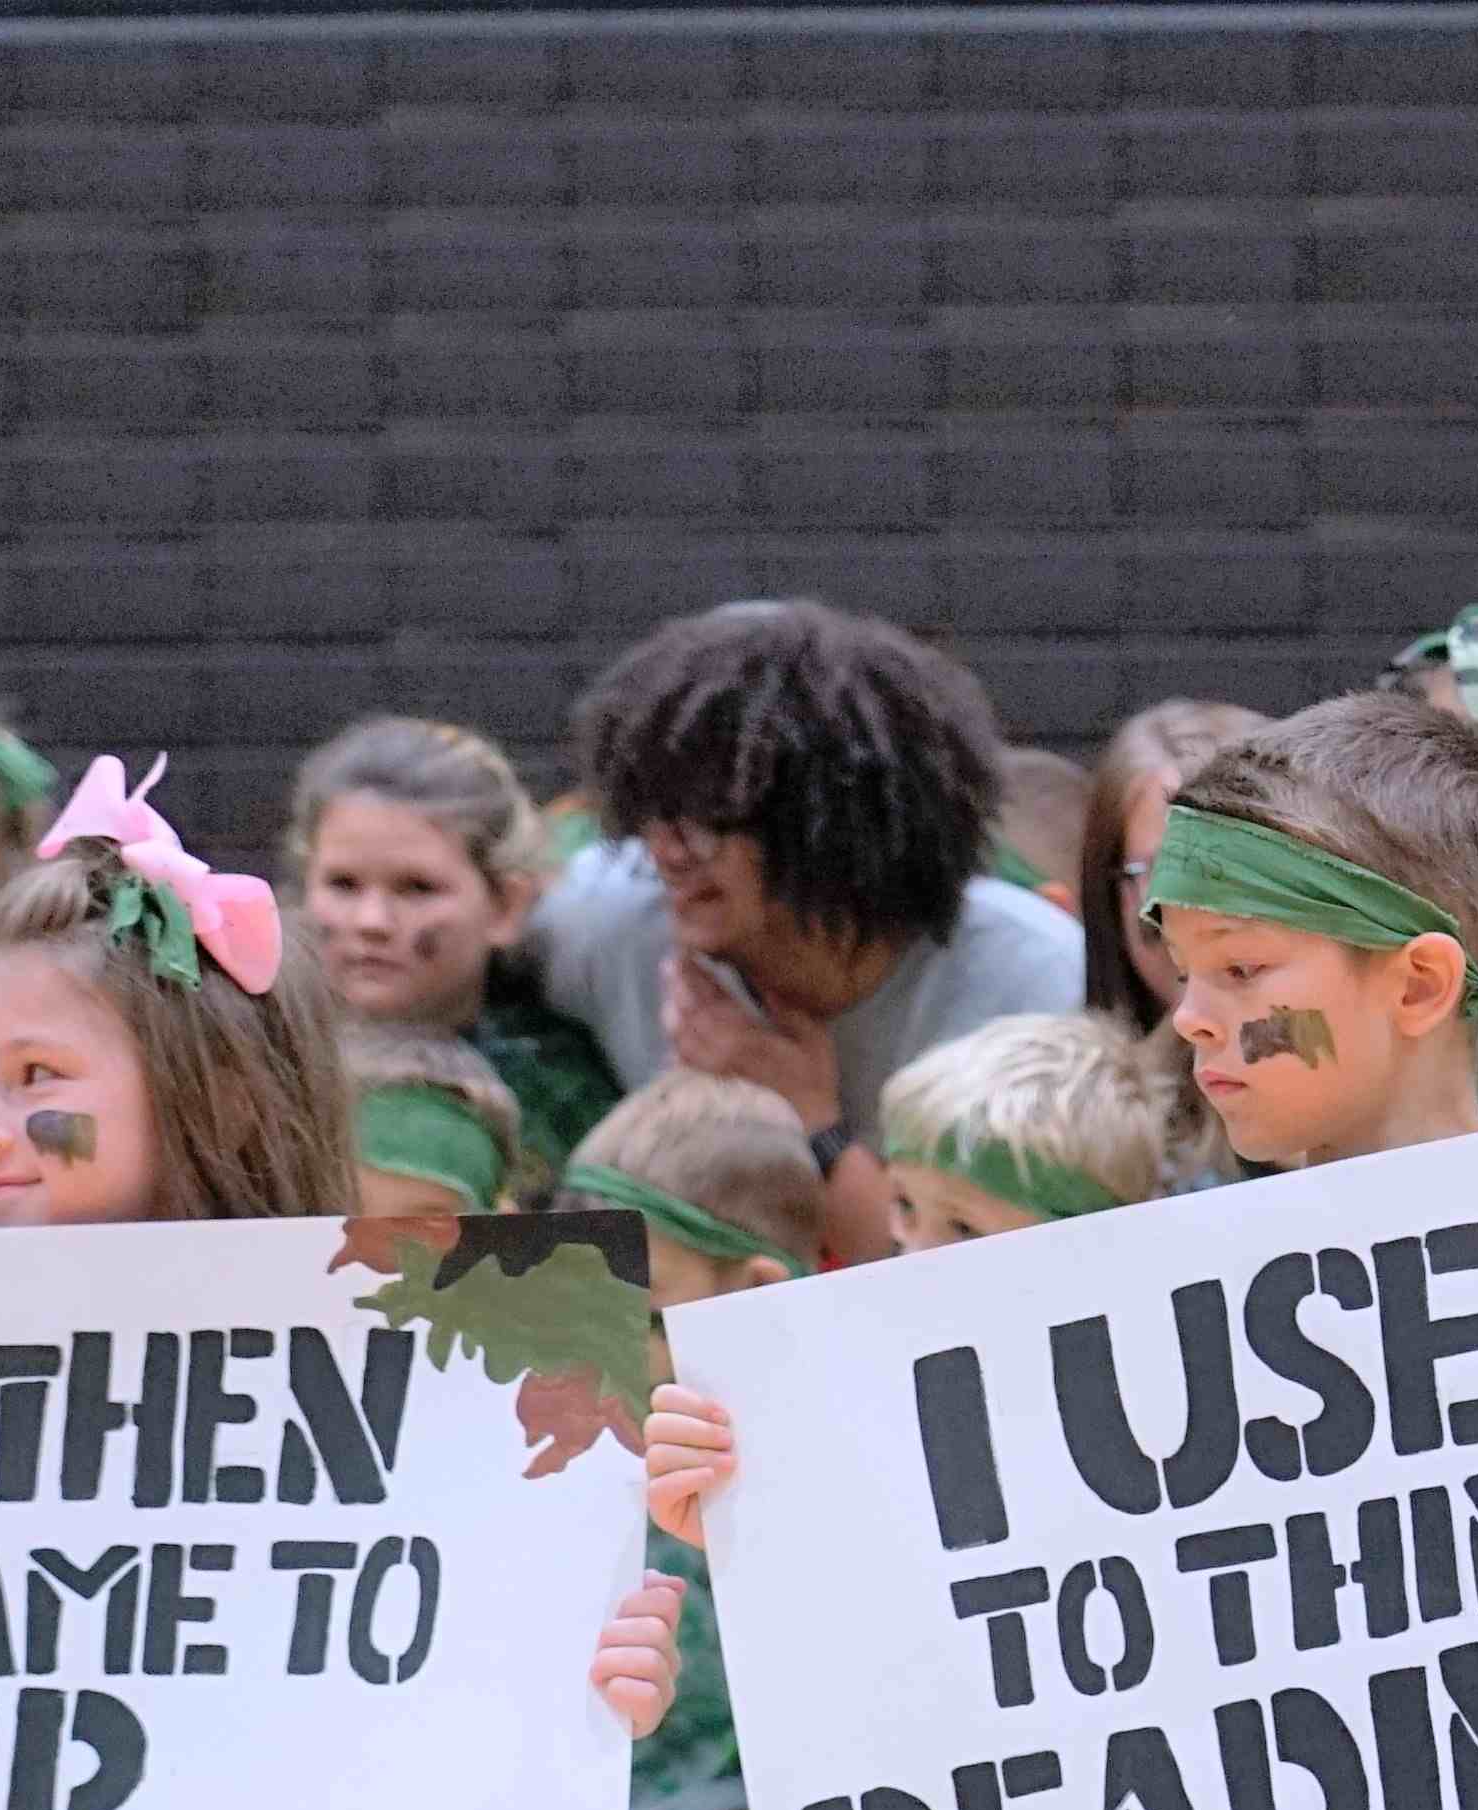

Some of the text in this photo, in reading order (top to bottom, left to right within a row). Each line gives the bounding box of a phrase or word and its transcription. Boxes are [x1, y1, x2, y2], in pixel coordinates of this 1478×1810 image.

[914, 1346, 1008, 1549] I
[271, 1536, 439, 1684] TO
[951, 1556, 1154, 1708] TO
